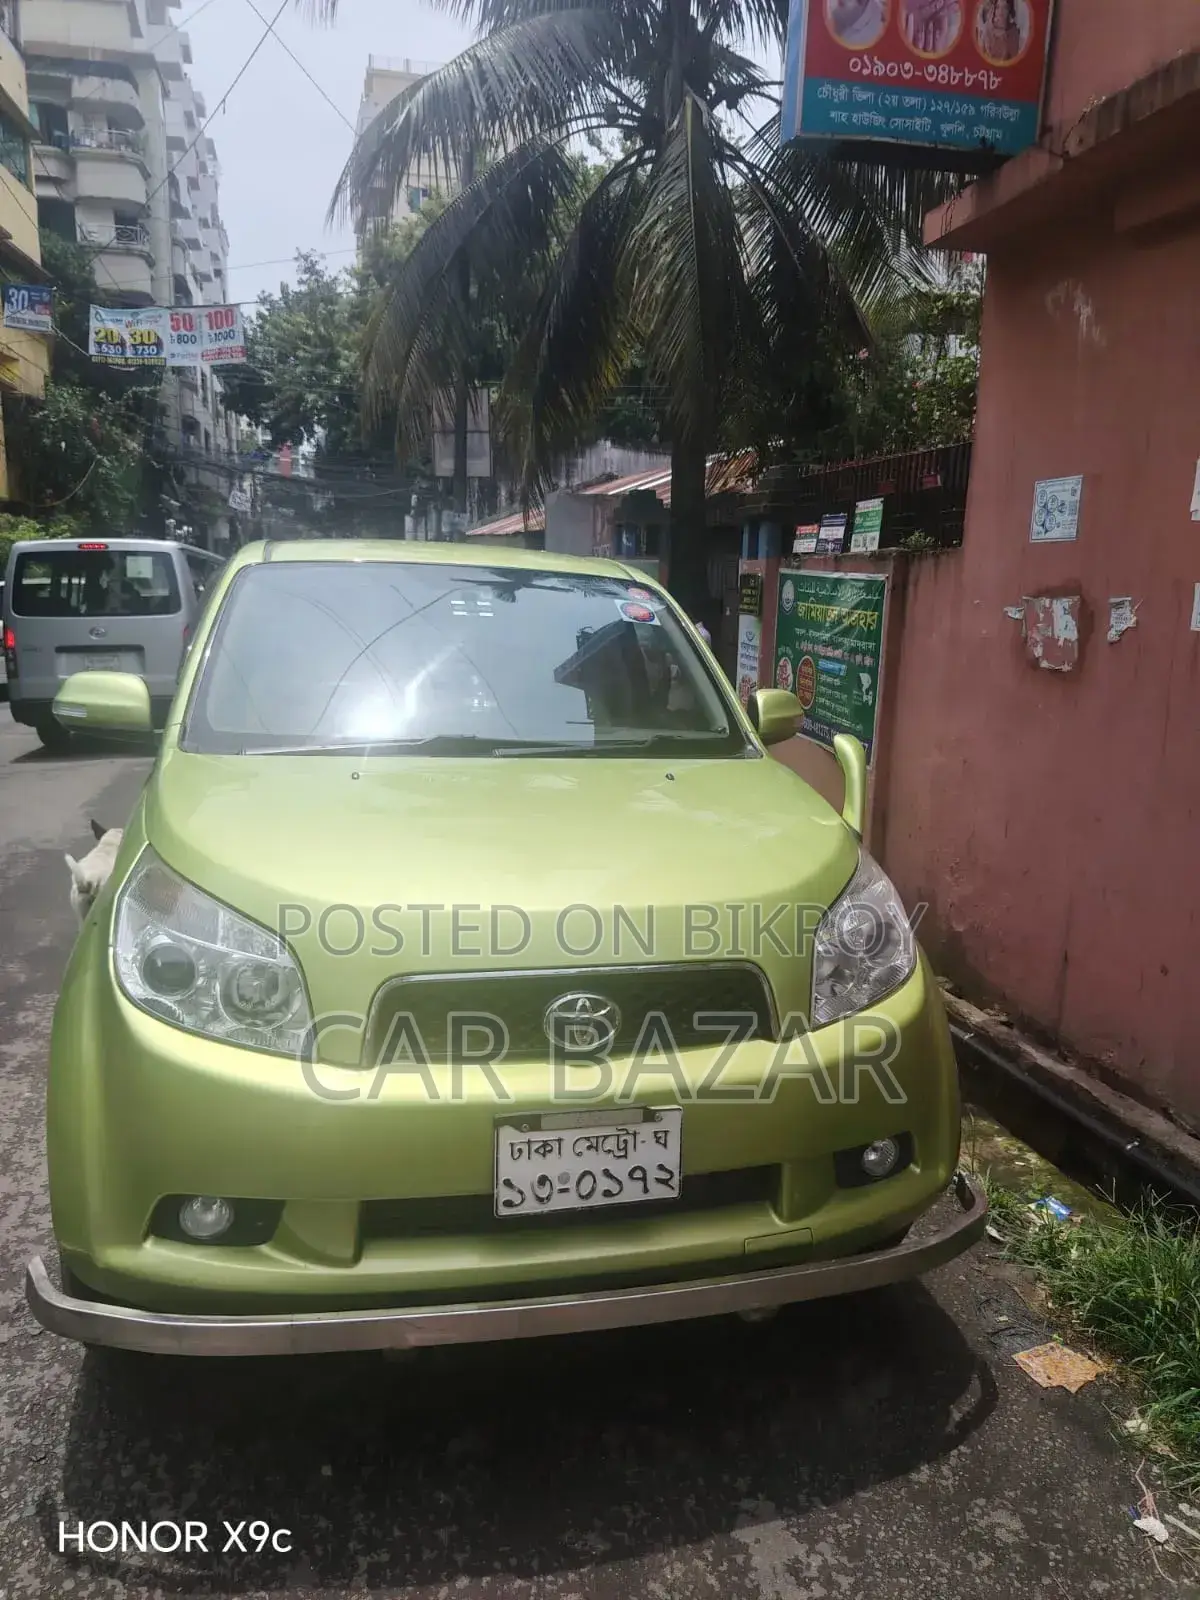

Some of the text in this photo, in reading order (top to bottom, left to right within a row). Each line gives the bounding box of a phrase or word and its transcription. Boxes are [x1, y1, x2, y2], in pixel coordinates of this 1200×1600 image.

[849, 54, 1003, 90] ০১৯০৩-৩৪৮৮৭৮
[170, 312, 194, 333] 50
[205, 308, 235, 331] 100
[95, 327, 120, 344] 20
[128, 328, 157, 345] 30
[177, 333, 197, 344] 800
[214, 329, 235, 342] 1000
[509, 1138, 563, 1160] ঢাকা
[502, 1163, 675, 1208] ১৩-০১৭২
